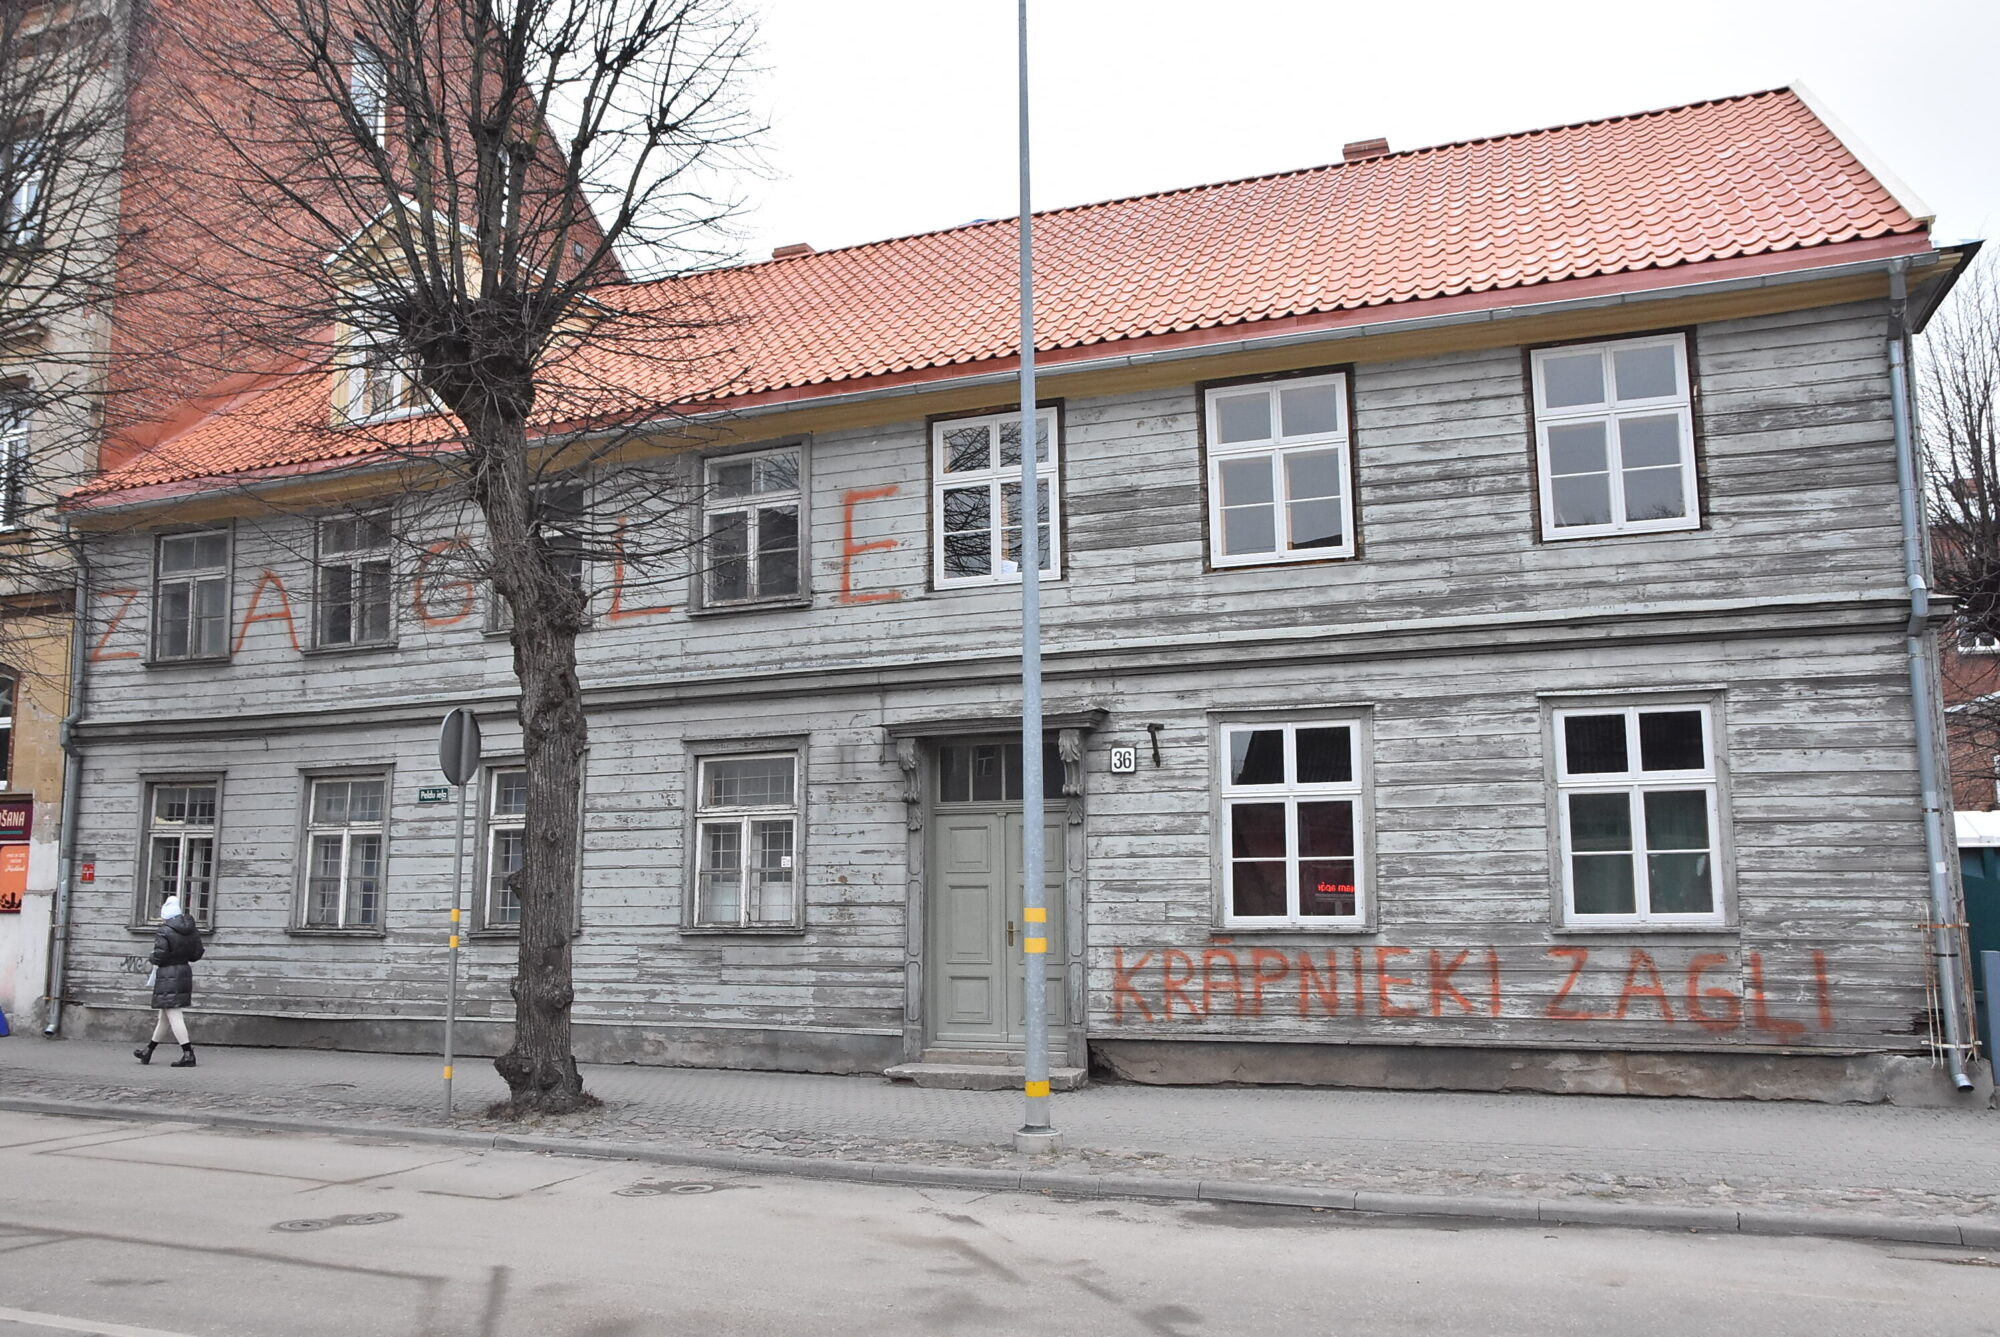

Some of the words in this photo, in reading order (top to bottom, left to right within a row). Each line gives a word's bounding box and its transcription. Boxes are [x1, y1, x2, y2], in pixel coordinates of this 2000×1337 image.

[1114, 751, 1132, 769] 36
[437, 789, 447, 800] iela
[0, 809, 26, 827] ŠANA
